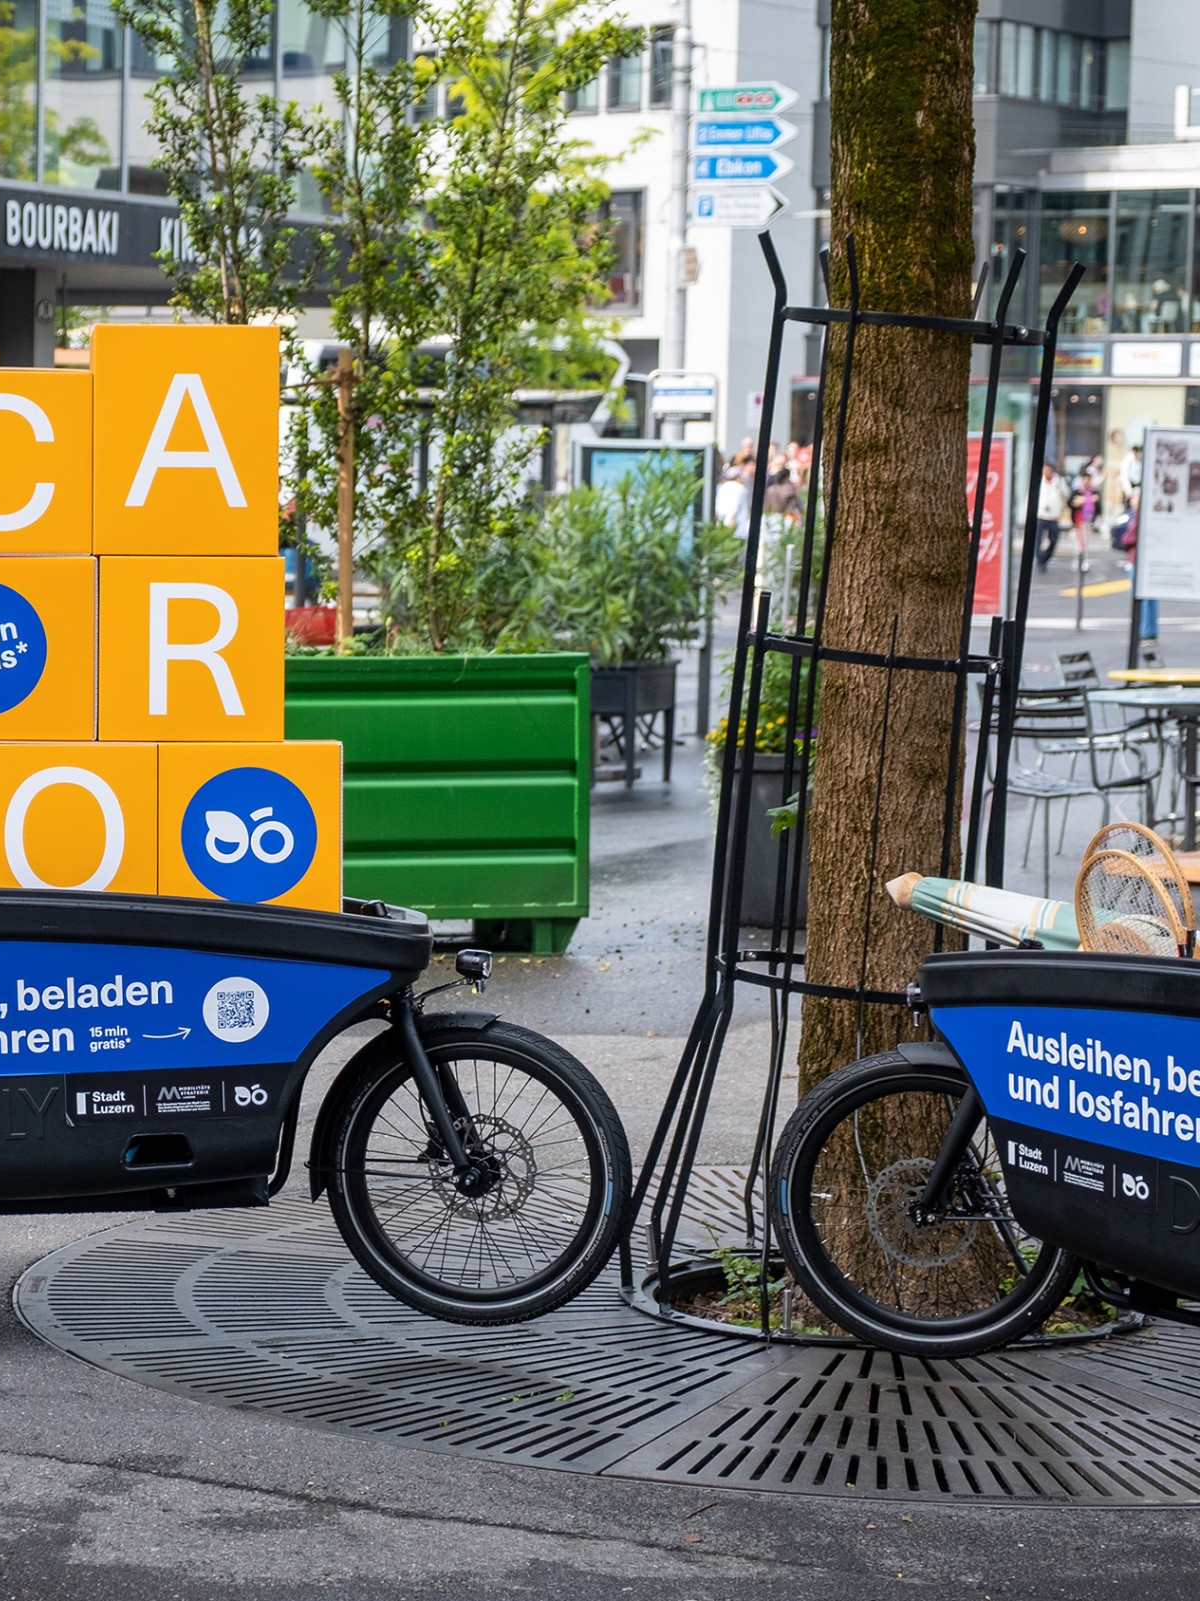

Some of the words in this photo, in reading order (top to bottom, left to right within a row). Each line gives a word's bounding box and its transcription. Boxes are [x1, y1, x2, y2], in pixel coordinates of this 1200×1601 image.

[6, 200, 119, 256] BOURBAKI
[124, 374, 248, 507] A
[148, 582, 245, 716] R
[4, 766, 125, 891] O
[17, 975, 173, 1011] beladen
[89, 1026, 103, 1037] 15
[104, 1025, 128, 1037] min
[1006, 1021, 1160, 1095] Ausleihen,
[92, 1090, 126, 1103] Stadt
[93, 1103, 135, 1115] Luzern
[1008, 1073, 1059, 1109] und
[1069, 1079, 1200, 1144] losfahre
[1018, 1143, 1042, 1161] Stadt
[1018, 1156, 1049, 1175] Luzern
